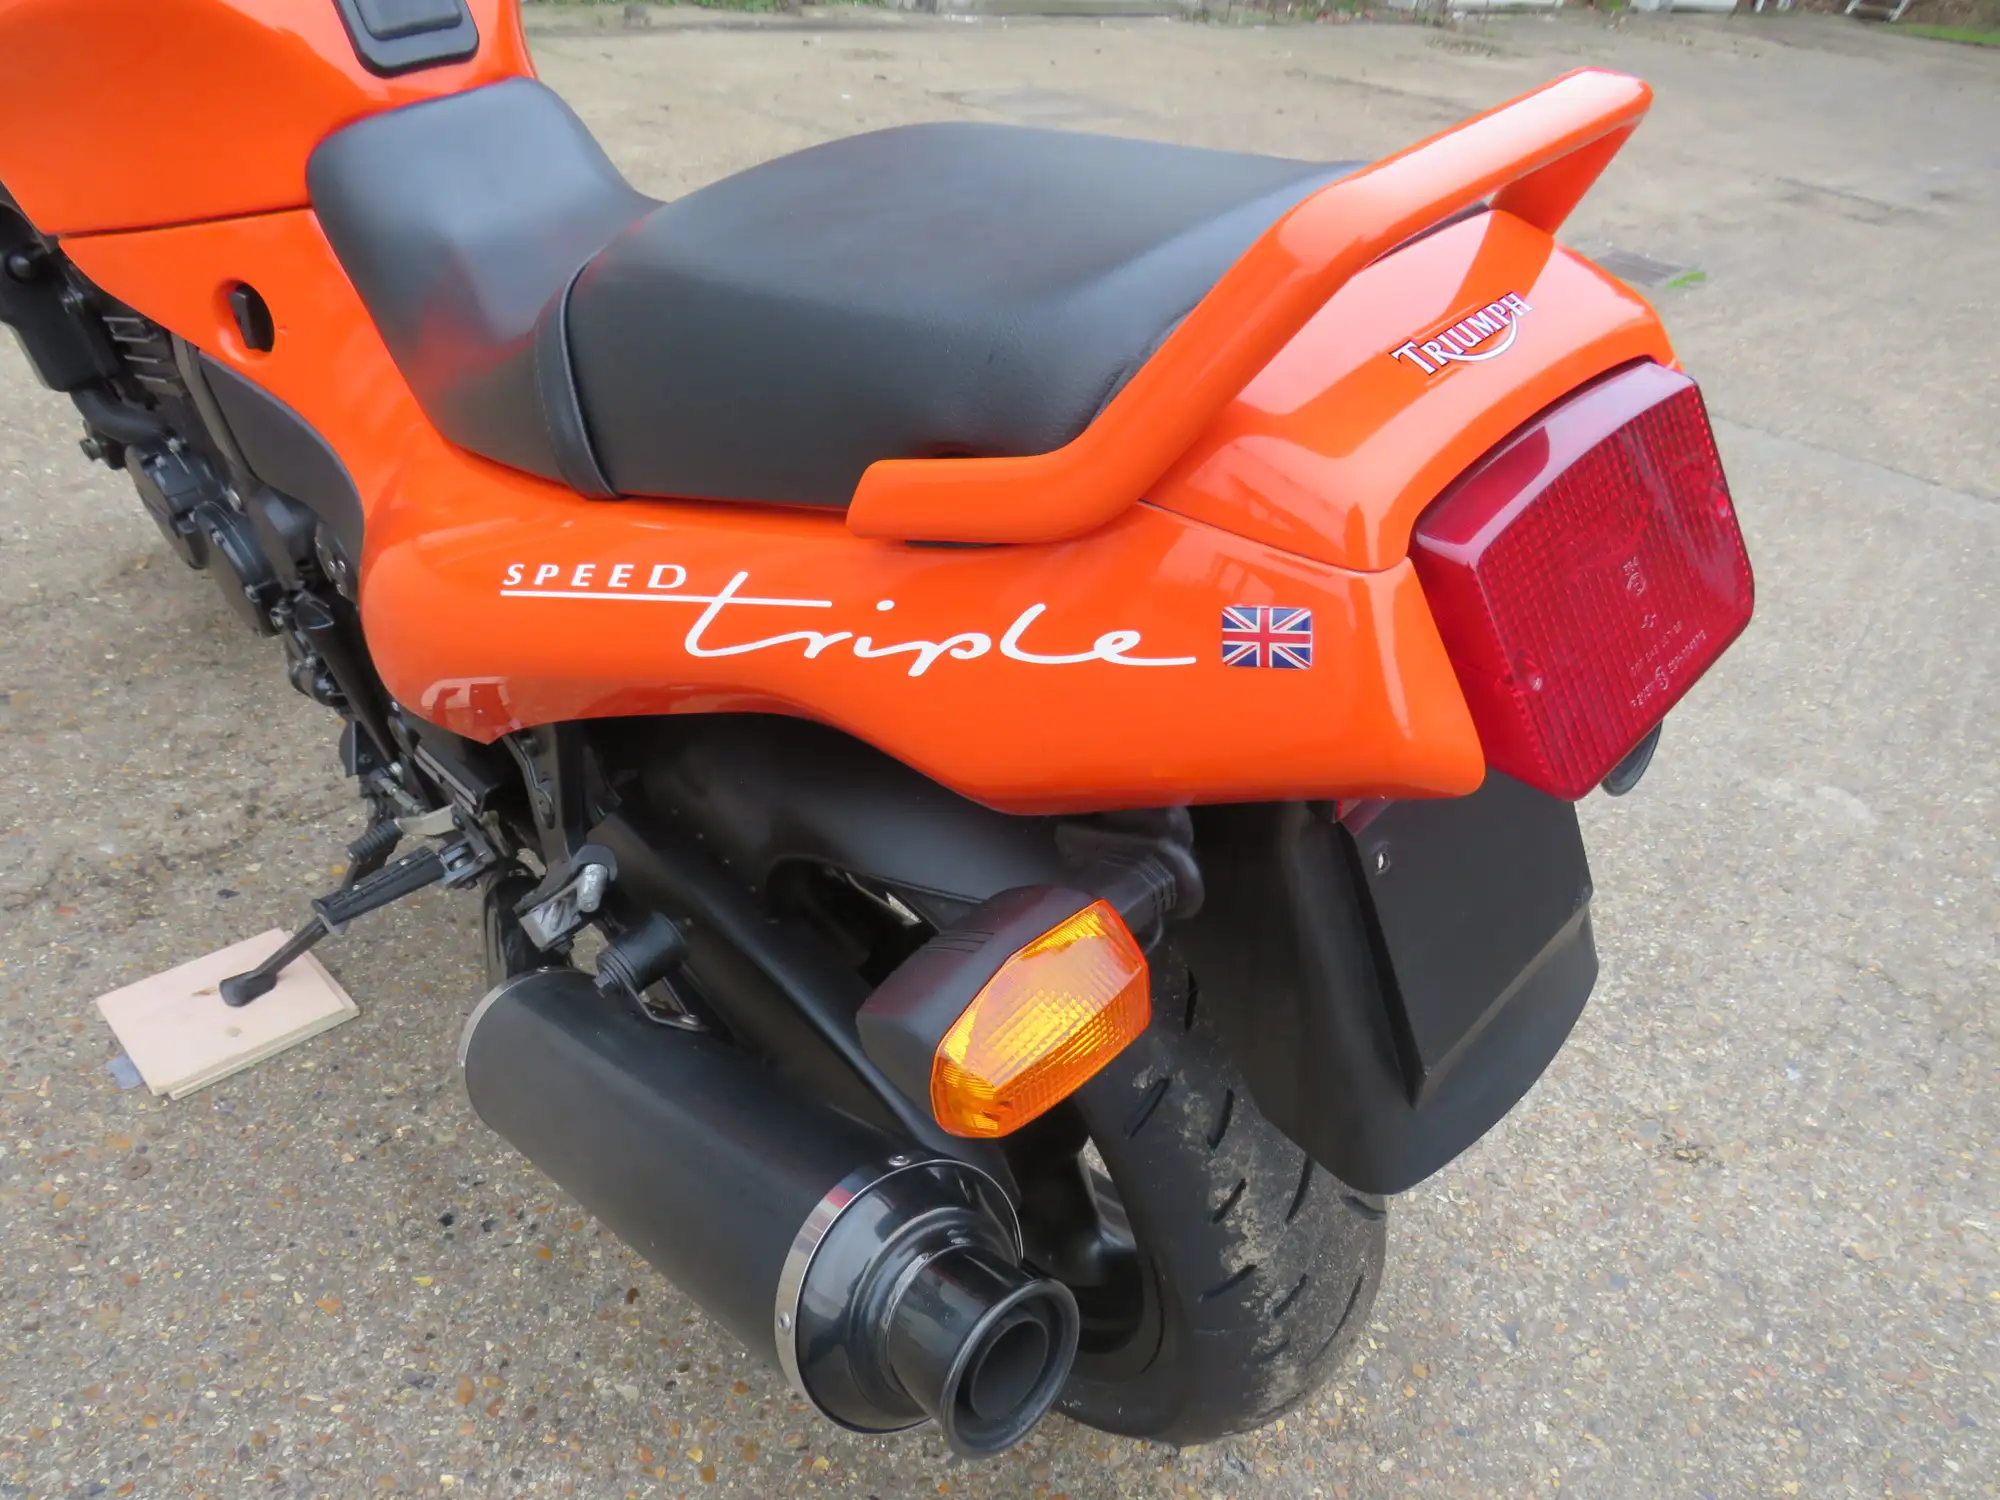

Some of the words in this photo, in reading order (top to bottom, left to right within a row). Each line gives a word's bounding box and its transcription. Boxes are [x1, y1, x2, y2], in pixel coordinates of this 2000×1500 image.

[1389, 291, 1532, 375] TRIUMPH
[502, 562, 688, 590] SPEED
[684, 570, 1197, 677] triple
